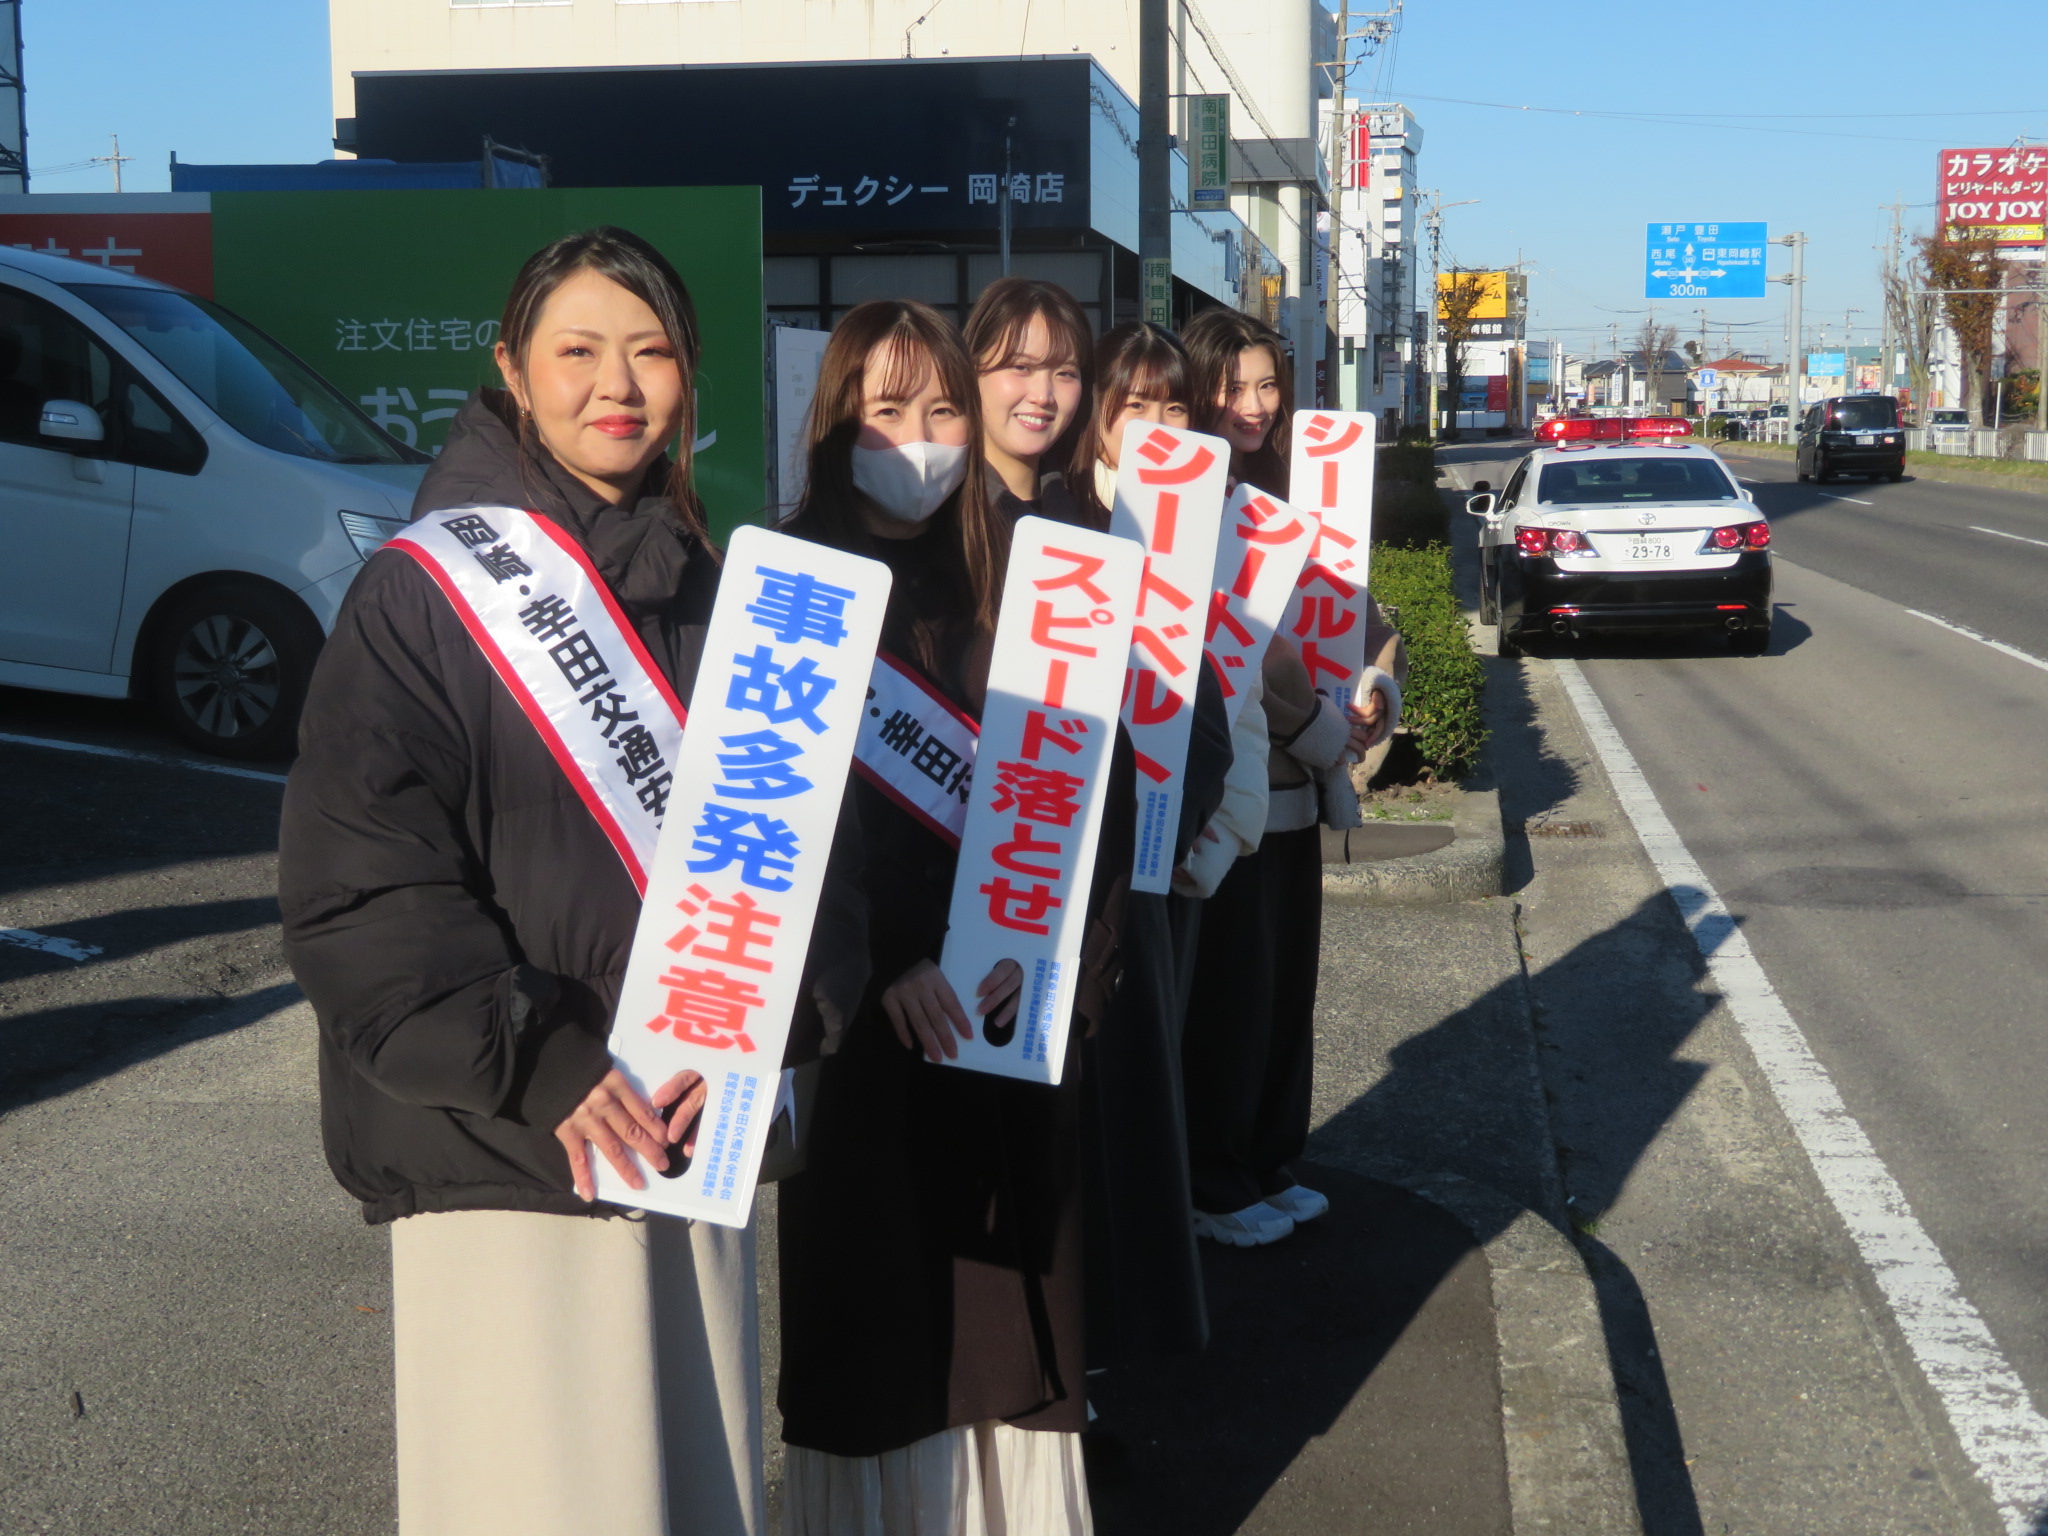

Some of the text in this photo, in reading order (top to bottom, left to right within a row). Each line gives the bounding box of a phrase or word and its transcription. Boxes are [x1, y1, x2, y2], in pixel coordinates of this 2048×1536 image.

[1201, 99, 1218, 187] 南豊田病院
[1947, 153, 2046, 177] カラオケ
[788, 172, 1065, 208] デュクシー 岡崎店
[1945, 201, 2045, 222] JOY JOY
[1669, 284, 1707, 296] 300m
[1437, 324, 1503, 336] 不情報館
[1292, 414, 1364, 688] シートベルト
[1632, 545, 1671, 558] 29-78
[979, 545, 1115, 936] スピード落とせ
[644, 565, 857, 1054] 事故多発注意
[720, 1075, 758, 1201] 岡崎幸田交通安全協会
